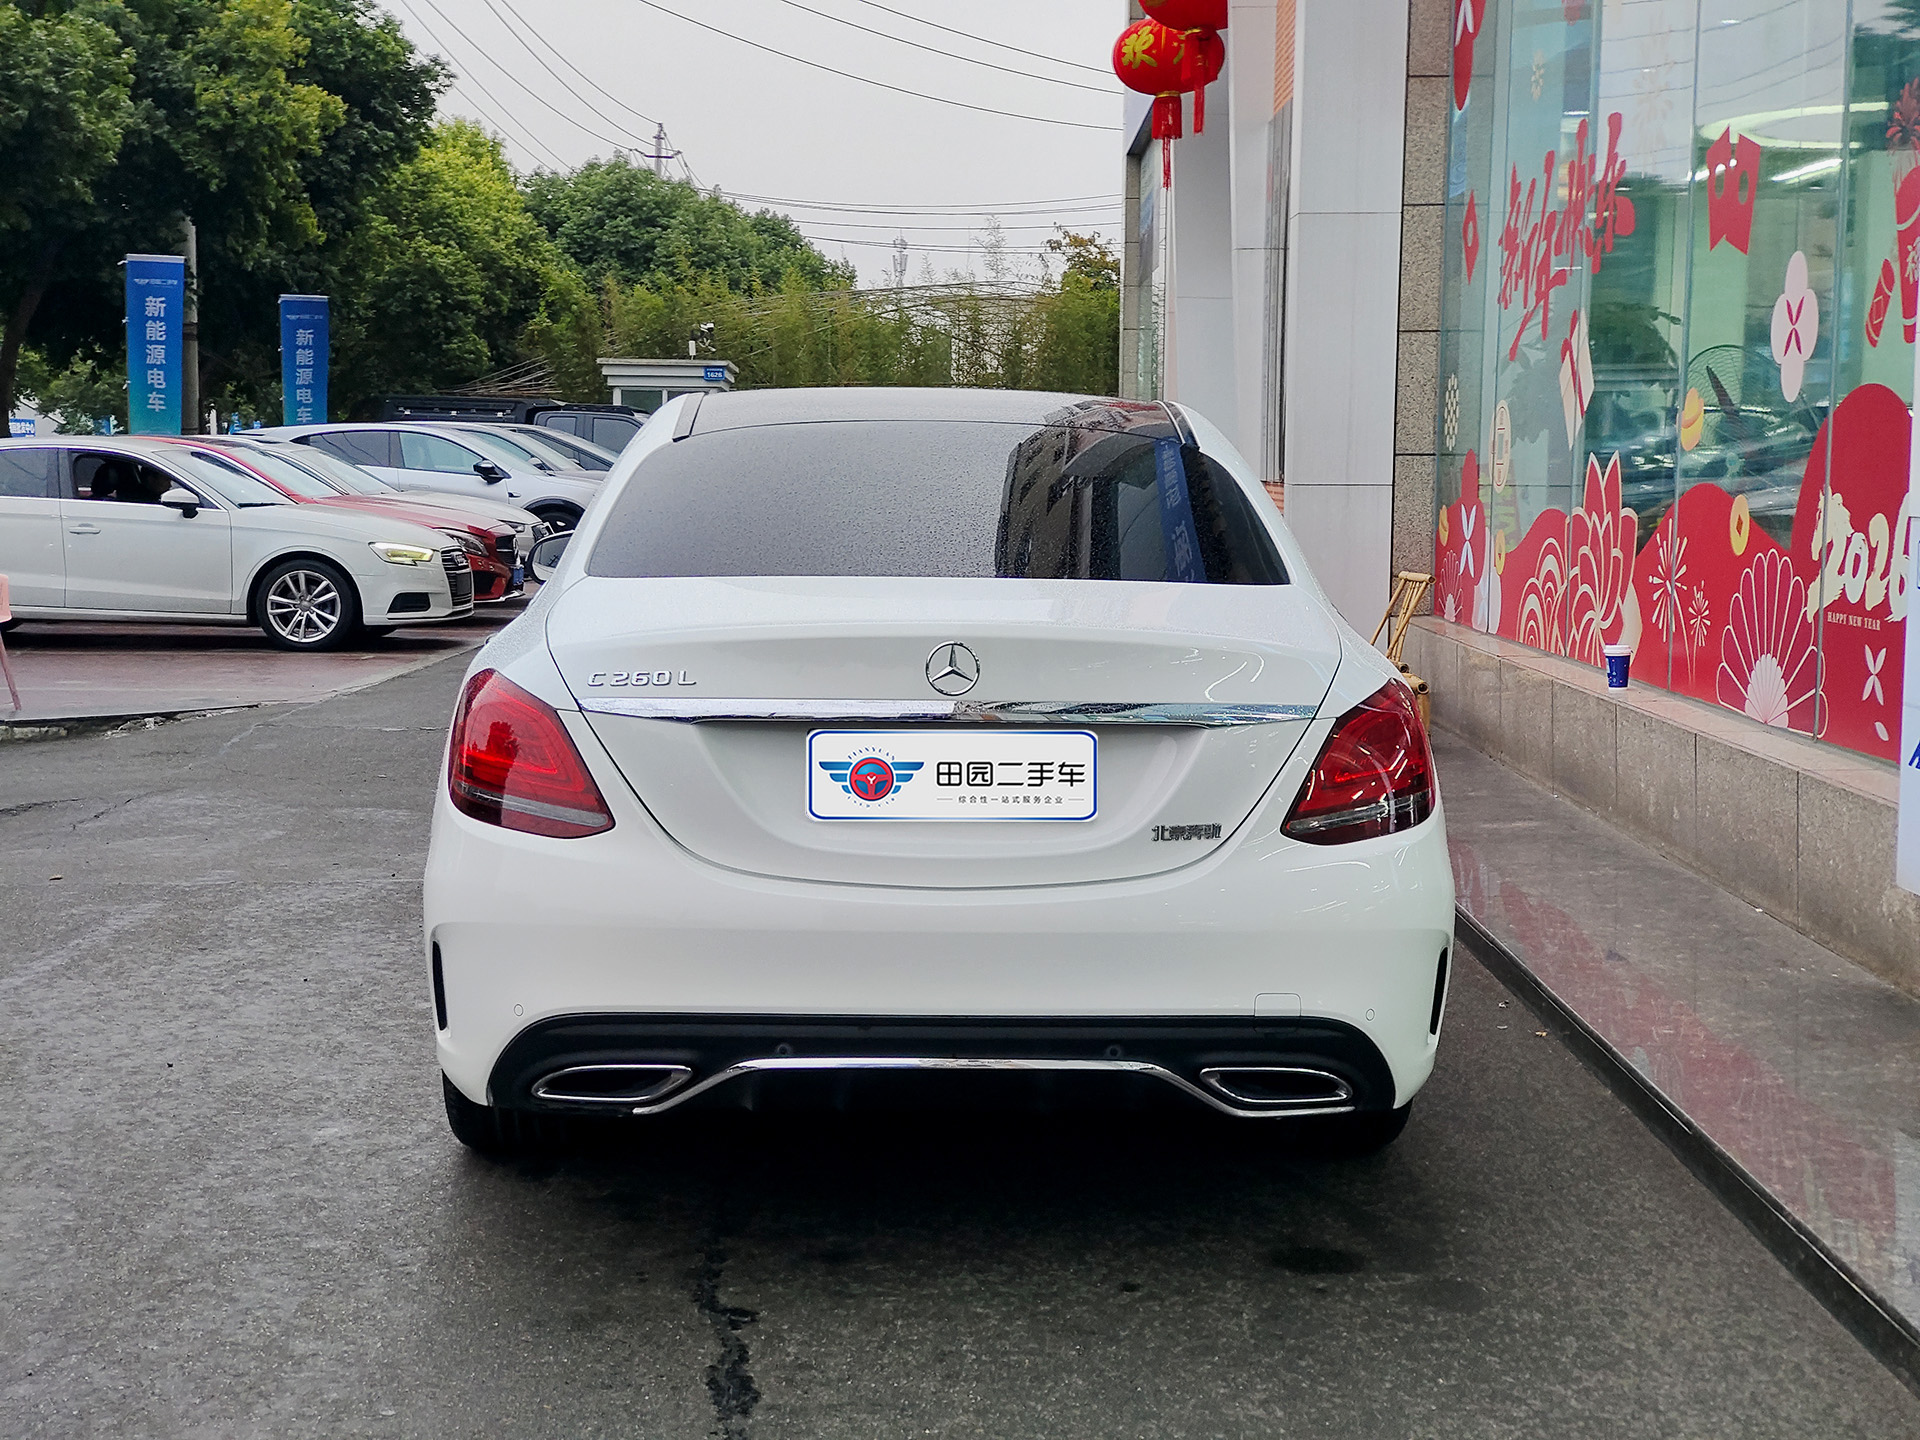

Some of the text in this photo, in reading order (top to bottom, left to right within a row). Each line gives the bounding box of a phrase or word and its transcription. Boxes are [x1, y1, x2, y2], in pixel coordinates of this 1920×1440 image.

[145, 296, 167, 412] 新能源电车
[295, 328, 315, 423] 新能源电车
[1827, 611, 1881, 631] HAPPY NEW YEAR
[587, 670, 697, 687] C 260 L
[1151, 822, 1222, 842] 北京奔驰
